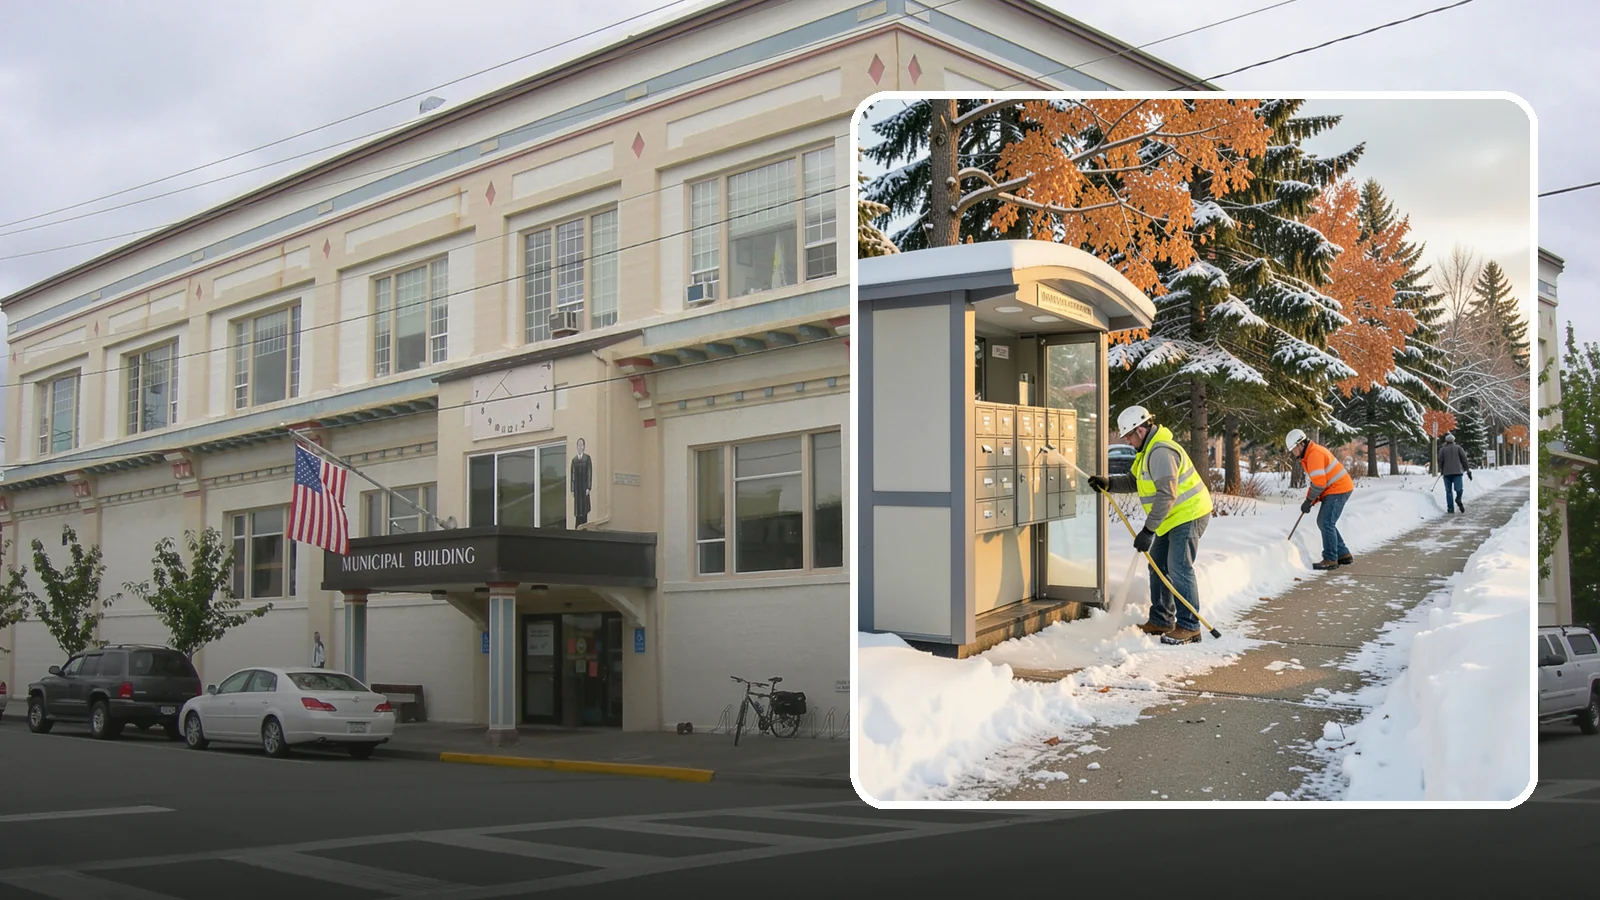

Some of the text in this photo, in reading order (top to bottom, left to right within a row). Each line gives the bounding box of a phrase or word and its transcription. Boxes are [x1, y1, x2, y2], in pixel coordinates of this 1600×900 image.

[481, 407, 485, 415] 8
[488, 418, 492, 426] 9
[529, 414, 533, 422] 3
[508, 425, 513, 433] 12
[342, 546, 475, 571] MUNICIPAL BUILDING
